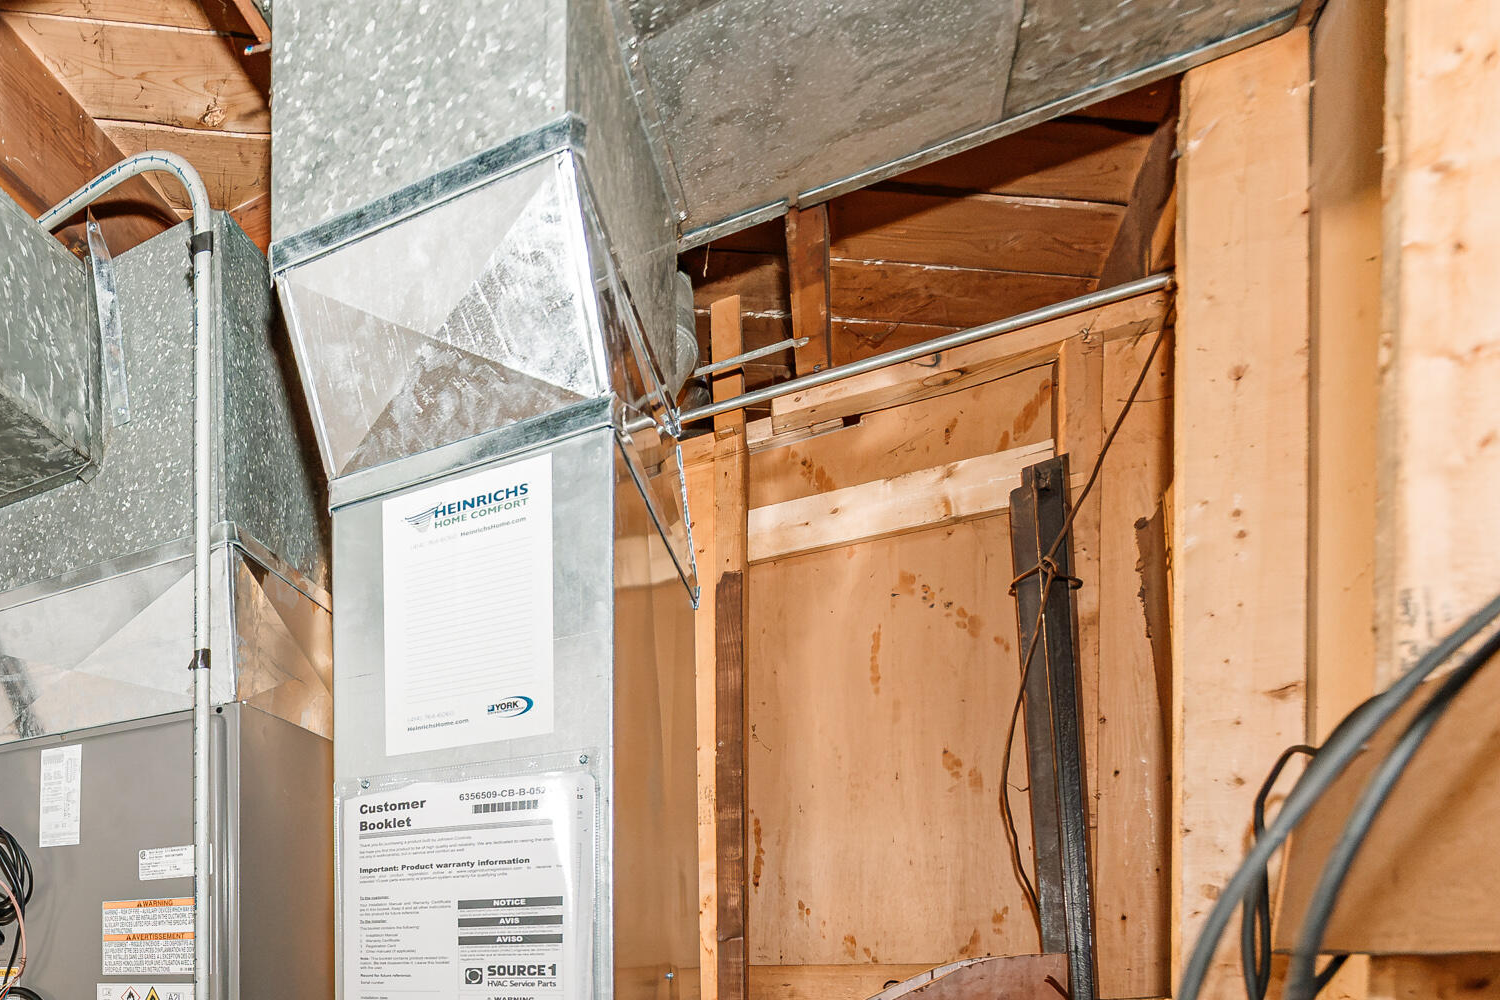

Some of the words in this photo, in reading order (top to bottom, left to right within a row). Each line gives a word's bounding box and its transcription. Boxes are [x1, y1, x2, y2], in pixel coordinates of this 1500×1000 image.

[434, 483, 529, 518] HEINRICHS
[434, 514, 467, 529] HOME
[470, 498, 529, 519] COMFORT
[460, 516, 527, 537] HeinrichsHome.com
[495, 700, 519, 711] YORK
[360, 799, 426, 814] Customer
[360, 816, 412, 831] Booklet
[360, 866, 399, 874] Important:
[401, 863, 433, 871] Product
[478, 857, 530, 866] information
[142, 899, 173, 907] WARNING
[487, 964, 546, 976] SOURCE
[548, 963, 557, 976] 1
